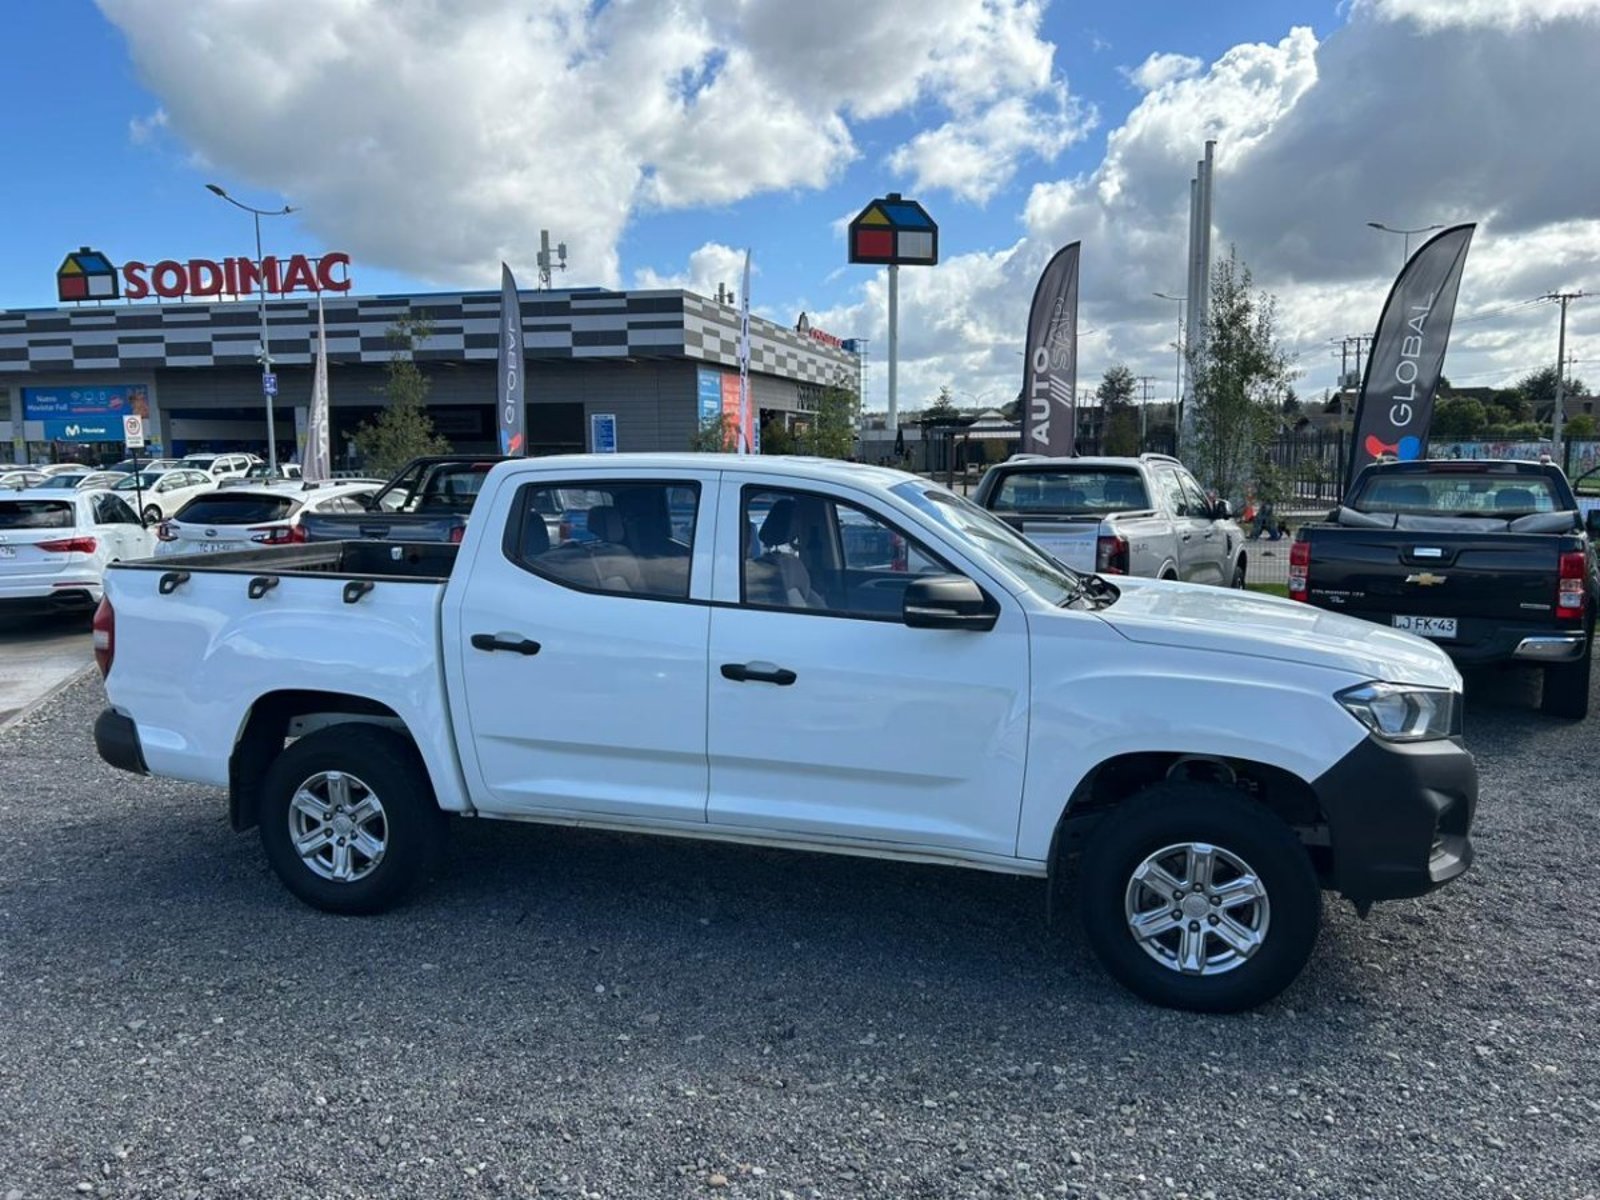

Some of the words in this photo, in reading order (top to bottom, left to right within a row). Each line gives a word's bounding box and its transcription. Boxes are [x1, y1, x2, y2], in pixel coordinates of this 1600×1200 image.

[122, 252, 352, 299] SODIMAC
[1031, 346, 1051, 447] AUTO
[1389, 292, 1434, 427] GLOBAL
